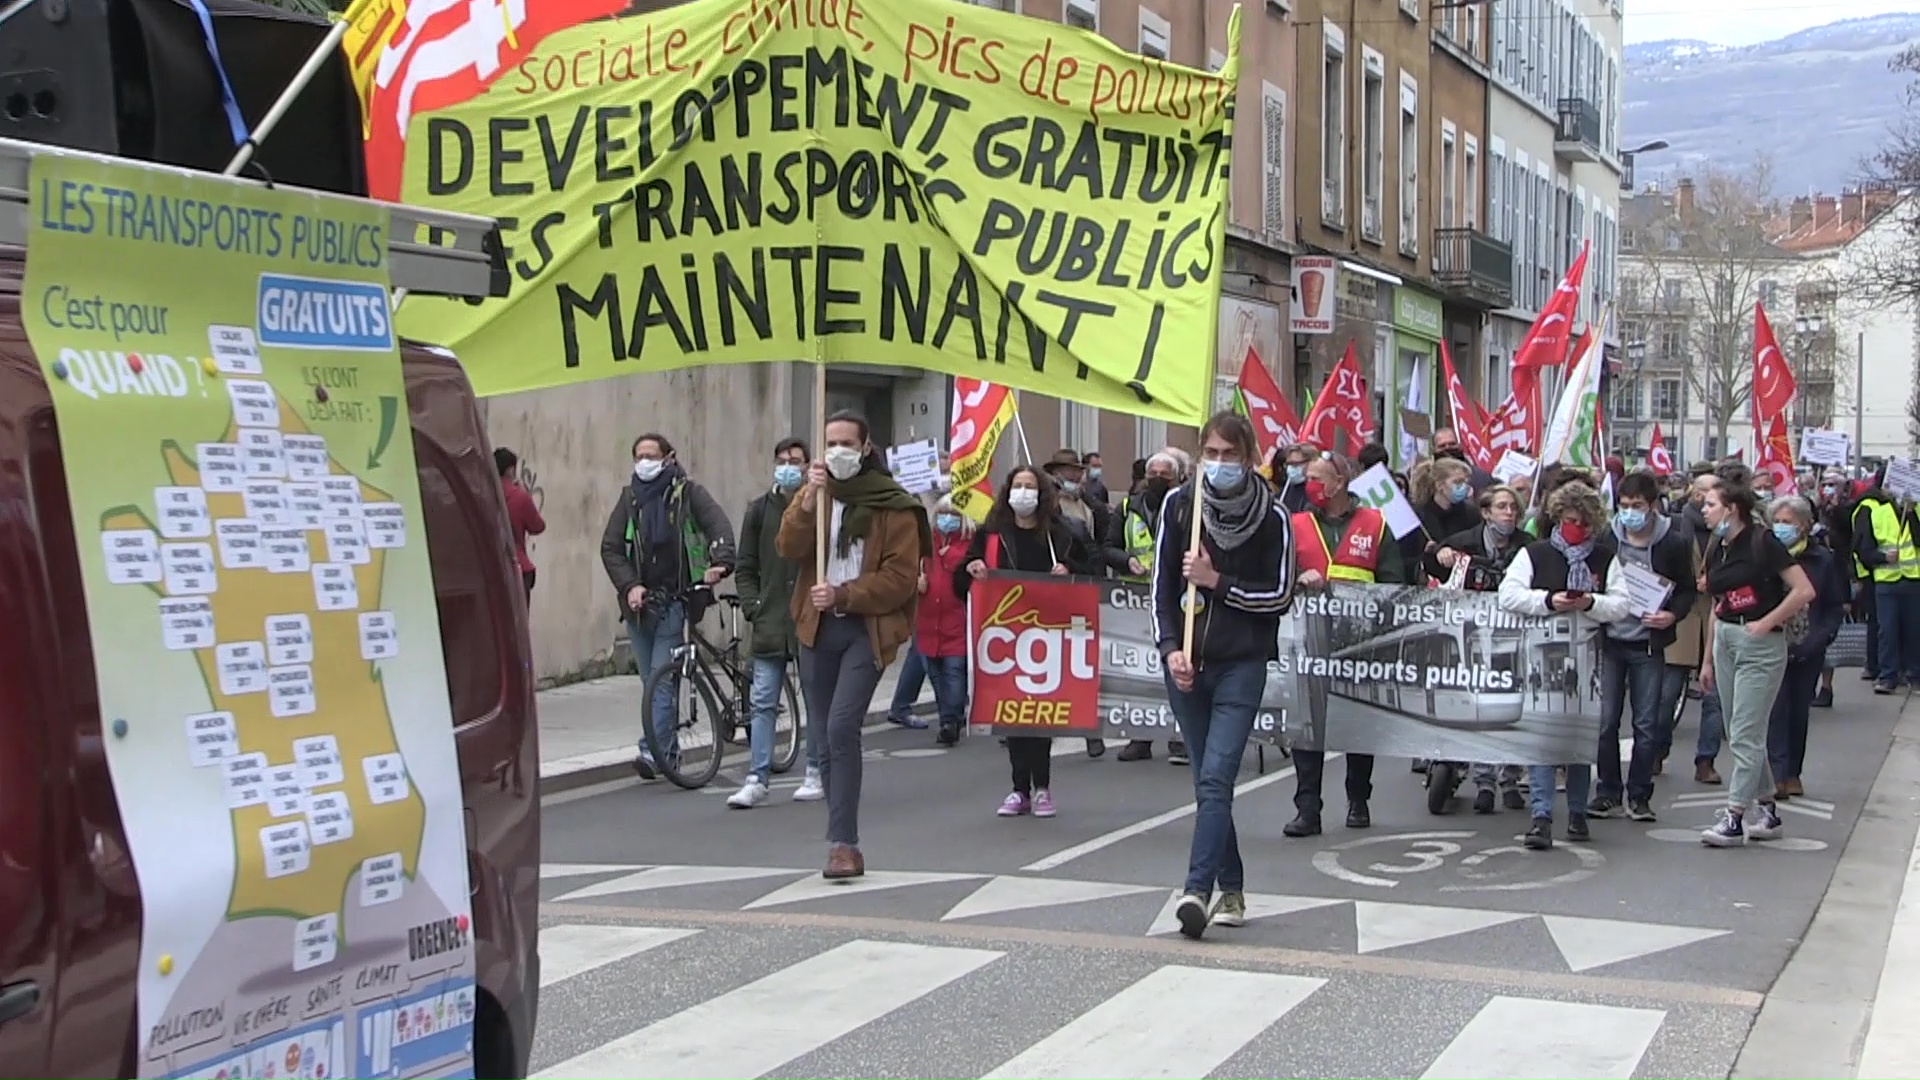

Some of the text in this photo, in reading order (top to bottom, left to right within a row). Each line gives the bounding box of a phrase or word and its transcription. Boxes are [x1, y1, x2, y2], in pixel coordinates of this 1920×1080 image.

[516, 24, 703, 94] sociale,
[902, 16, 1005, 84] pics
[1019, 38, 1079, 106] de
[42, 179, 382, 268] LES TRANSPORTS PUBLICS
[43, 285, 168, 341] C'est pour
[261, 288, 386, 338] GRATUITS
[1292, 320, 1330, 330] TACOS
[59, 347, 188, 399] QUAND
[911, 402, 929, 416] 19
[1350, 534, 1372, 550] cgt
[981, 584, 1092, 629] la
[1392, 602, 1436, 626] pas
[1443, 601, 1465, 625] le
[977, 615, 1095, 694] cgt
[1110, 643, 1138, 666] La
[1297, 653, 1418, 684] transports
[1426, 663, 1514, 690] publics
[994, 695, 1072, 726] ISÈRE
[1109, 701, 1167, 727] c'est
[355, 964, 401, 990] CLIMAT
[150, 1004, 225, 1047] POLLUTION
